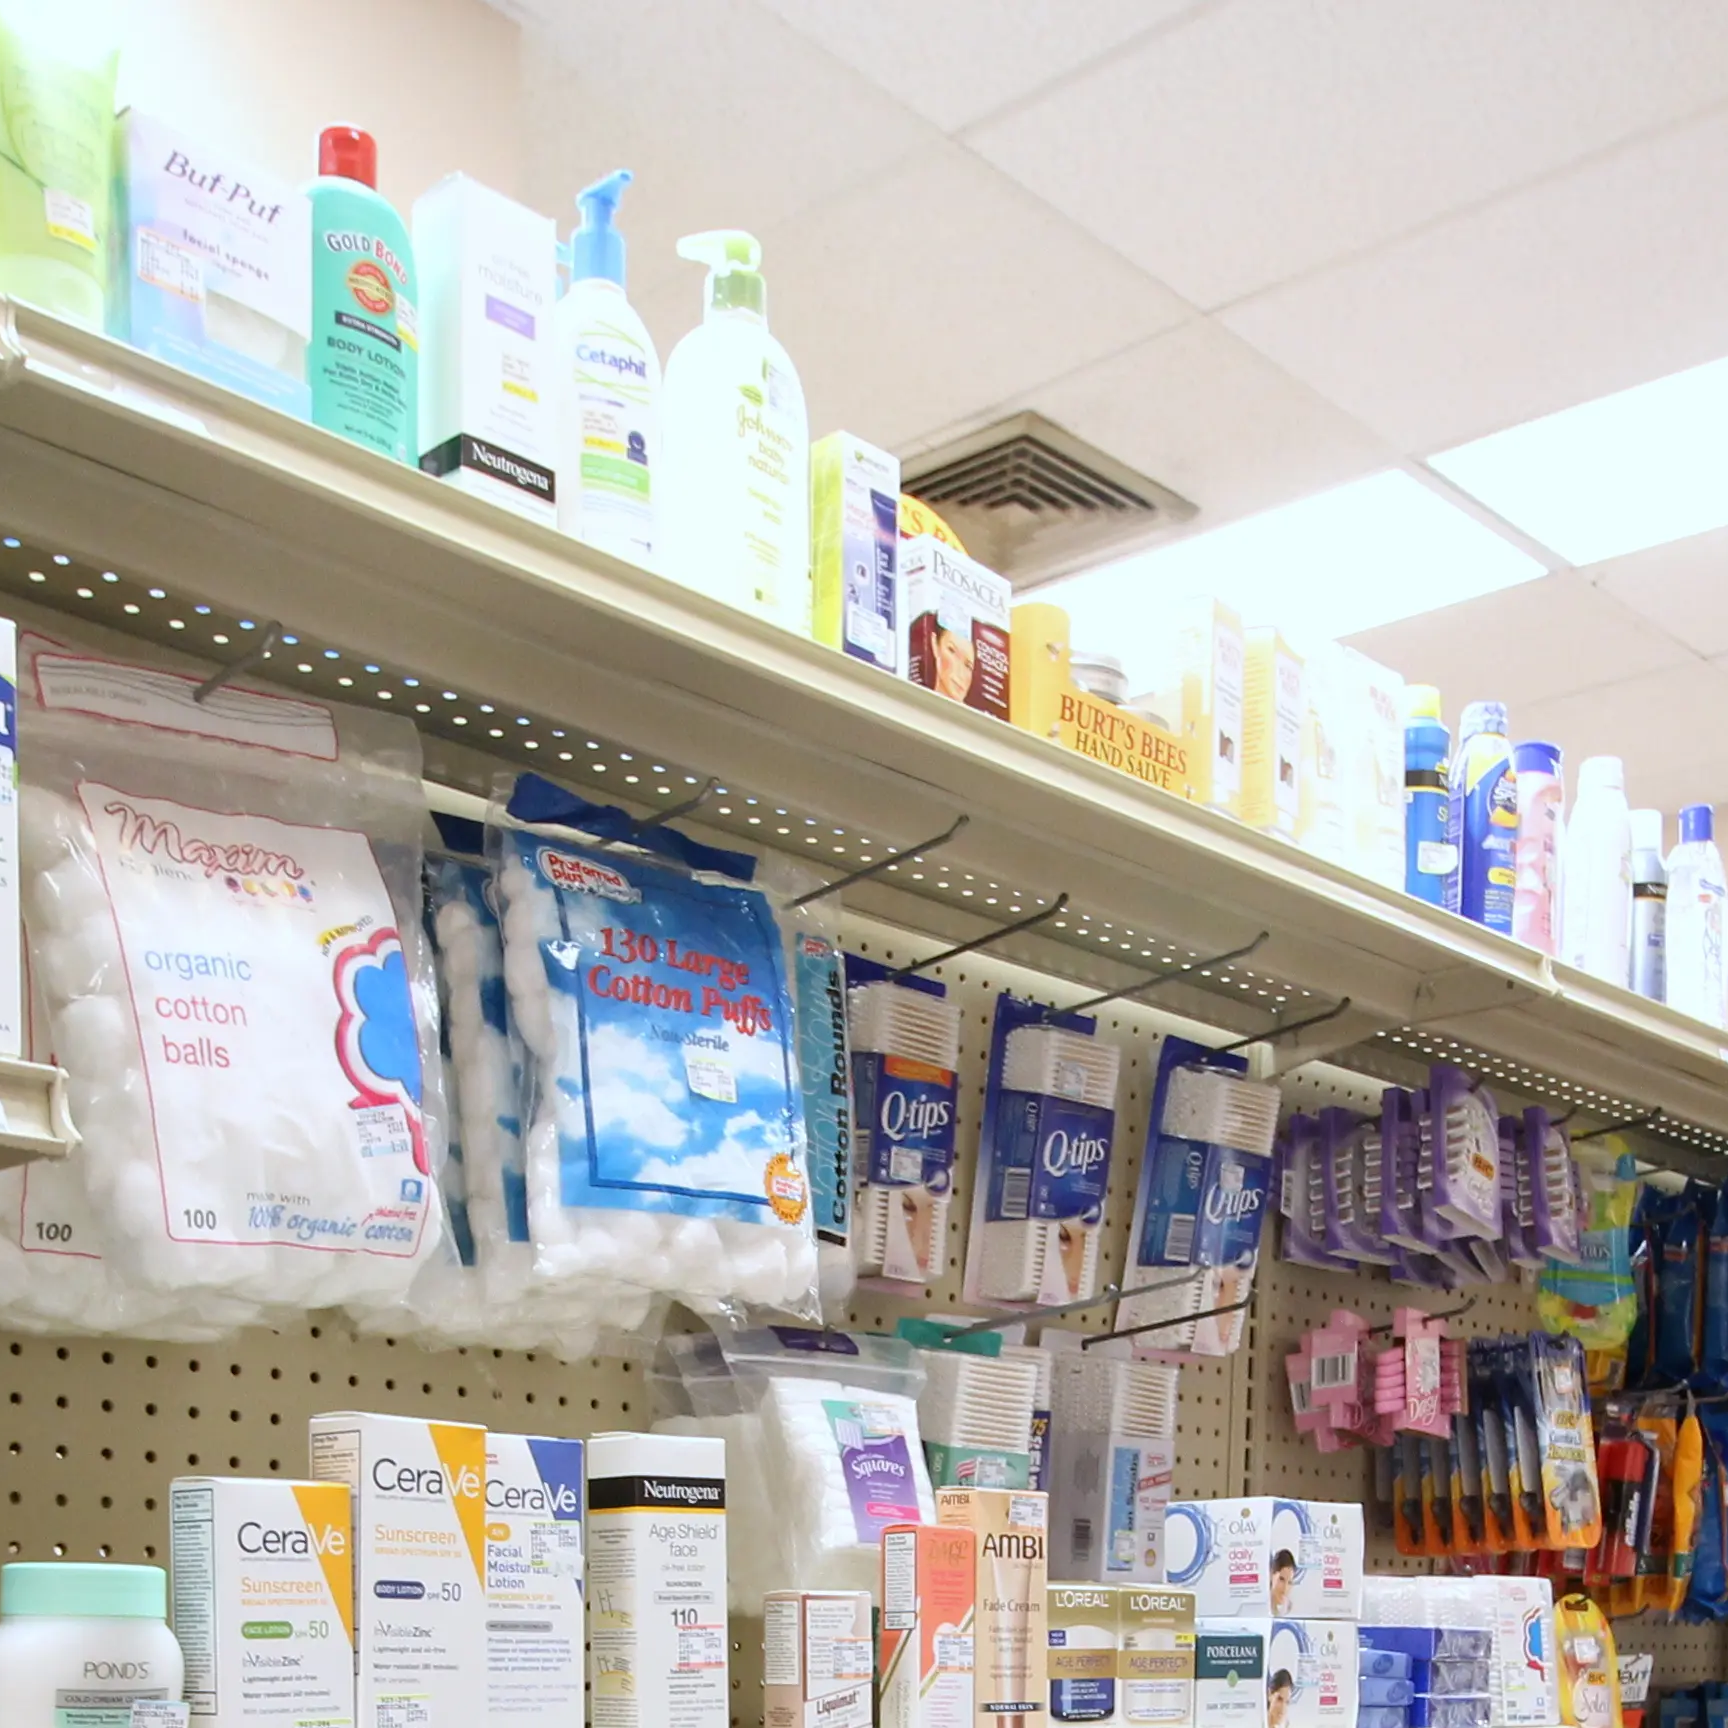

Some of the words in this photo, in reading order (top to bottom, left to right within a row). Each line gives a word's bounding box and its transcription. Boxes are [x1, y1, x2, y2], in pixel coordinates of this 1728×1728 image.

[163, 150, 282, 228] Buf-Puf
[326, 231, 371, 253] GOLD
[375, 238, 408, 286] BOND
[478, 263, 542, 306] moisture
[327, 336, 363, 356] BODY
[576, 344, 647, 379] Cetaphil
[472, 441, 550, 493] Neutrogena
[933, 550, 1007, 614] PROSACEA
[1059, 694, 1137, 752] BURT'S
[1141, 727, 1187, 776] BEES
[1075, 729, 1124, 769] HAND
[1126, 755, 1172, 791] SALVE
[104, 803, 305, 878] Maxim
[144, 945, 254, 987] organic
[599, 926, 658, 965] 130
[666, 938, 751, 992] Large
[155, 992, 248, 1029] cotton
[587, 964, 693, 1013] Cotton
[700, 988, 774, 1036] Puffs
[827, 968, 849, 1097] Rounds
[162, 1034, 231, 1070] balls
[880, 1090, 952, 1140] Q-tips
[830, 1108, 850, 1225] Cotton
[1042, 1130, 1107, 1177] Q-tips
[35, 1221, 73, 1244] 100
[183, 1208, 217, 1232] 100
[372, 1457, 481, 1502] CeraVe
[851, 1458, 906, 1481] Squares
[485, 1476, 577, 1513] CeraVe
[643, 1480, 720, 1504] Neutrogena
[236, 1521, 346, 1556] CeraVe
[375, 1524, 457, 1545] Sunscreen
[487, 1544, 523, 1560] Facial
[669, 1541, 698, 1558] face
[982, 1532, 1044, 1561] AMBI
[241, 1577, 323, 1595] Sunscreen
[440, 1582, 462, 1602] 50
[487, 1575, 525, 1590] Lotion
[308, 1620, 330, 1639] 50
[670, 1608, 699, 1627] 110
[1206, 1645, 1257, 1659] PORCELANA
